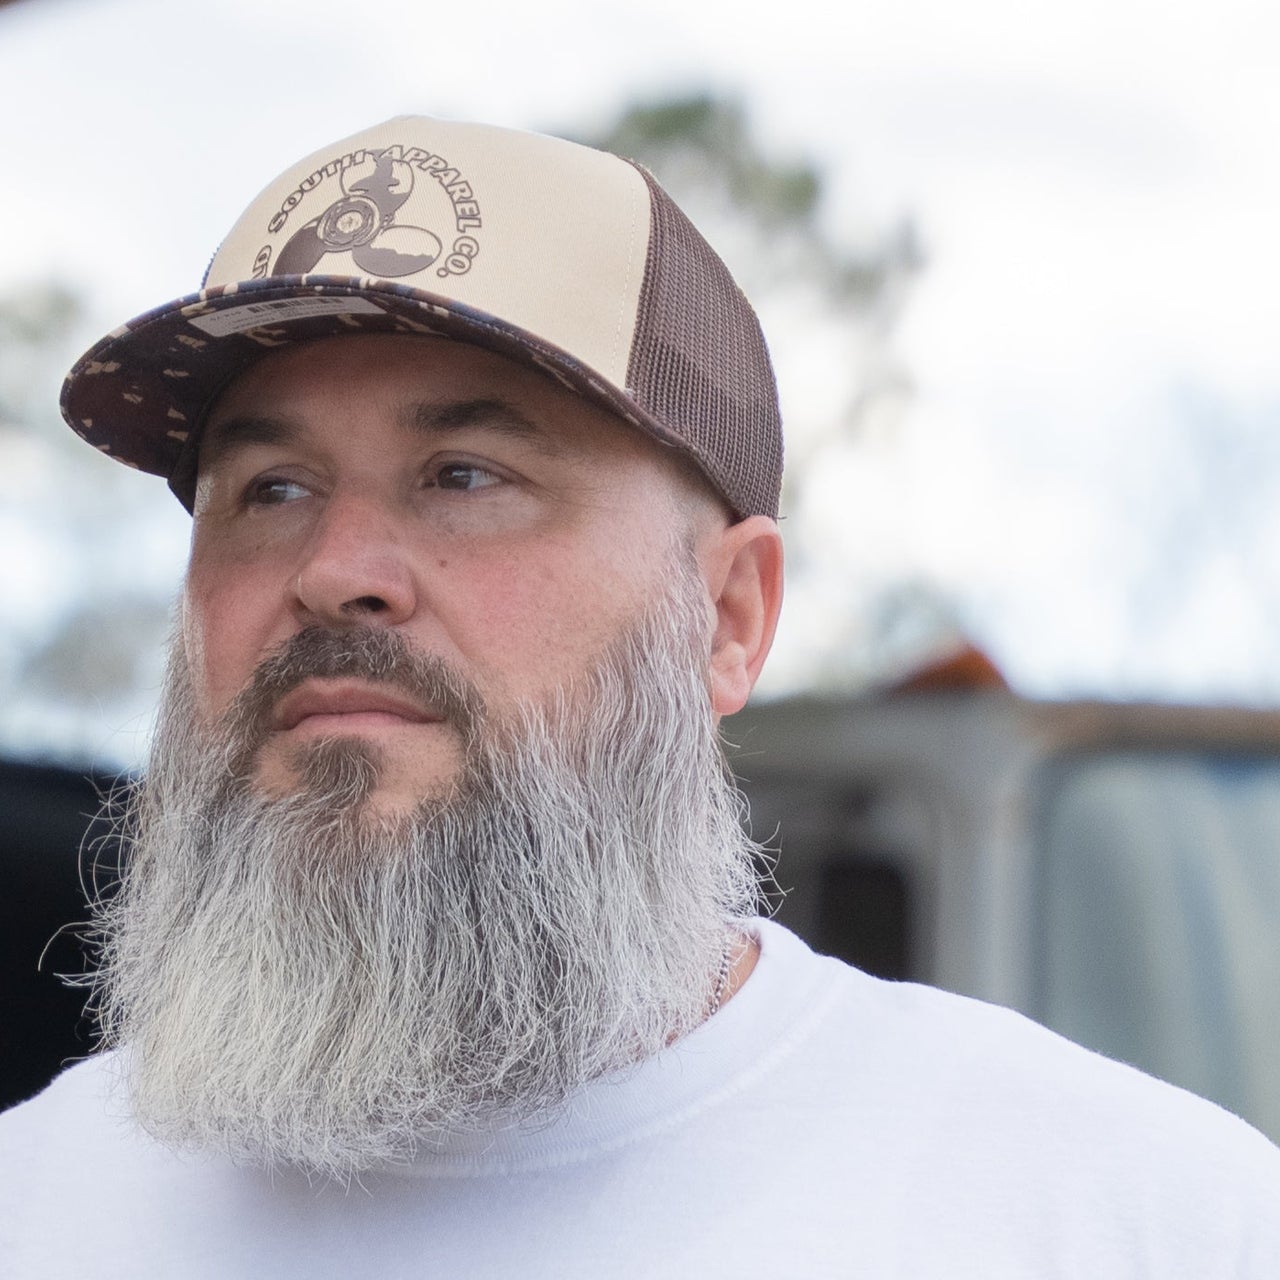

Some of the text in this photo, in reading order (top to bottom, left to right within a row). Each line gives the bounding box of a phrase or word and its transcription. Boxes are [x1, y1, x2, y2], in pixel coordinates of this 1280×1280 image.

[267, 148, 366, 233] SOUTH
[379, 144, 482, 233] APPAREL
[436, 235, 480, 278] CO.
